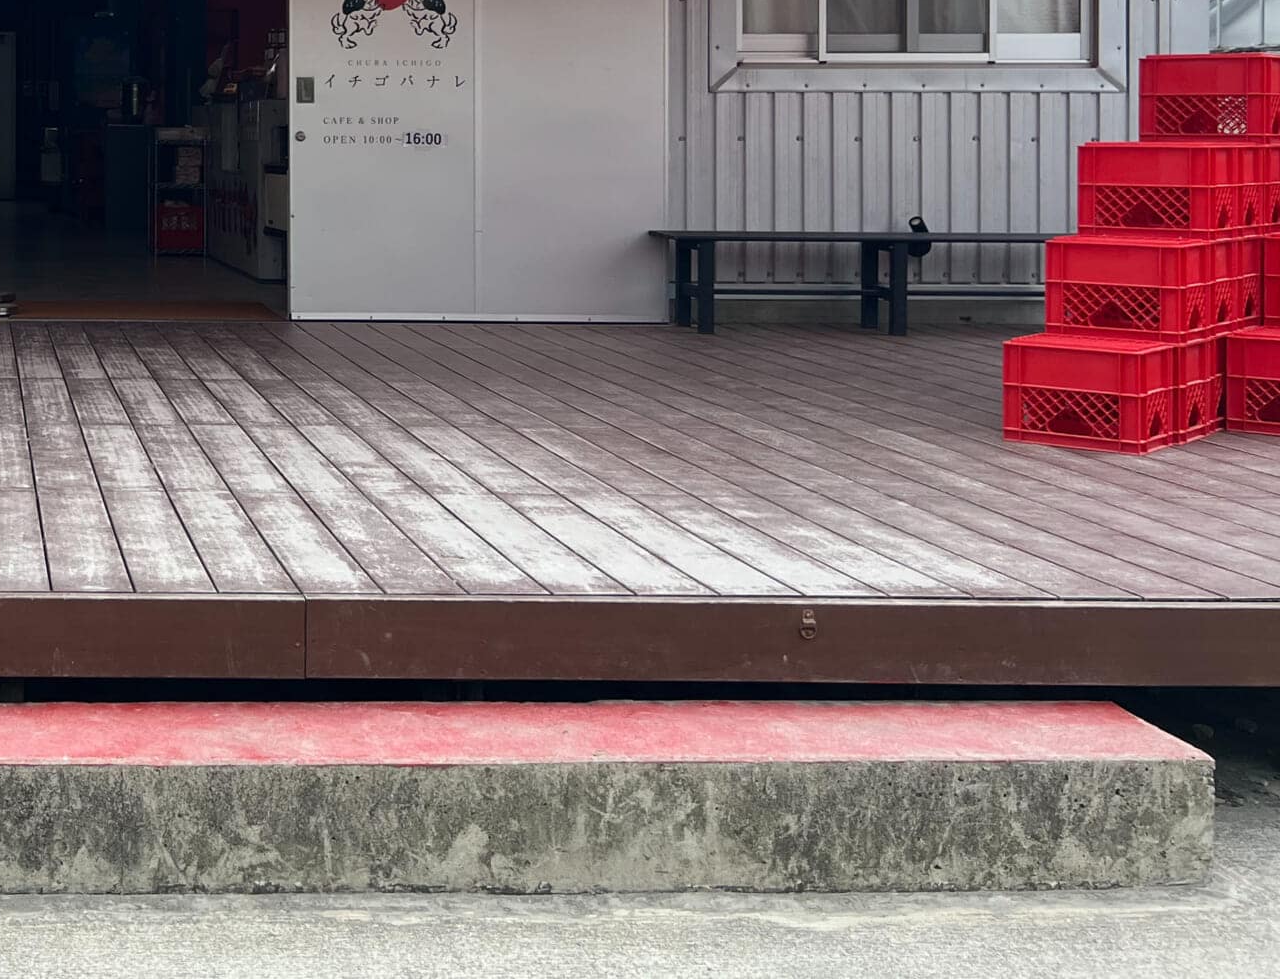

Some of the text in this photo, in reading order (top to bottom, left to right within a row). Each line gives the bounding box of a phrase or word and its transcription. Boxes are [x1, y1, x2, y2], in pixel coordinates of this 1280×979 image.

[347, 59, 442, 68] CHURA ICHIGO
[324, 74, 466, 88] イチゴバナレ
[322, 116, 400, 125] CAFE & SHOP
[323, 135, 357, 144] OPEN
